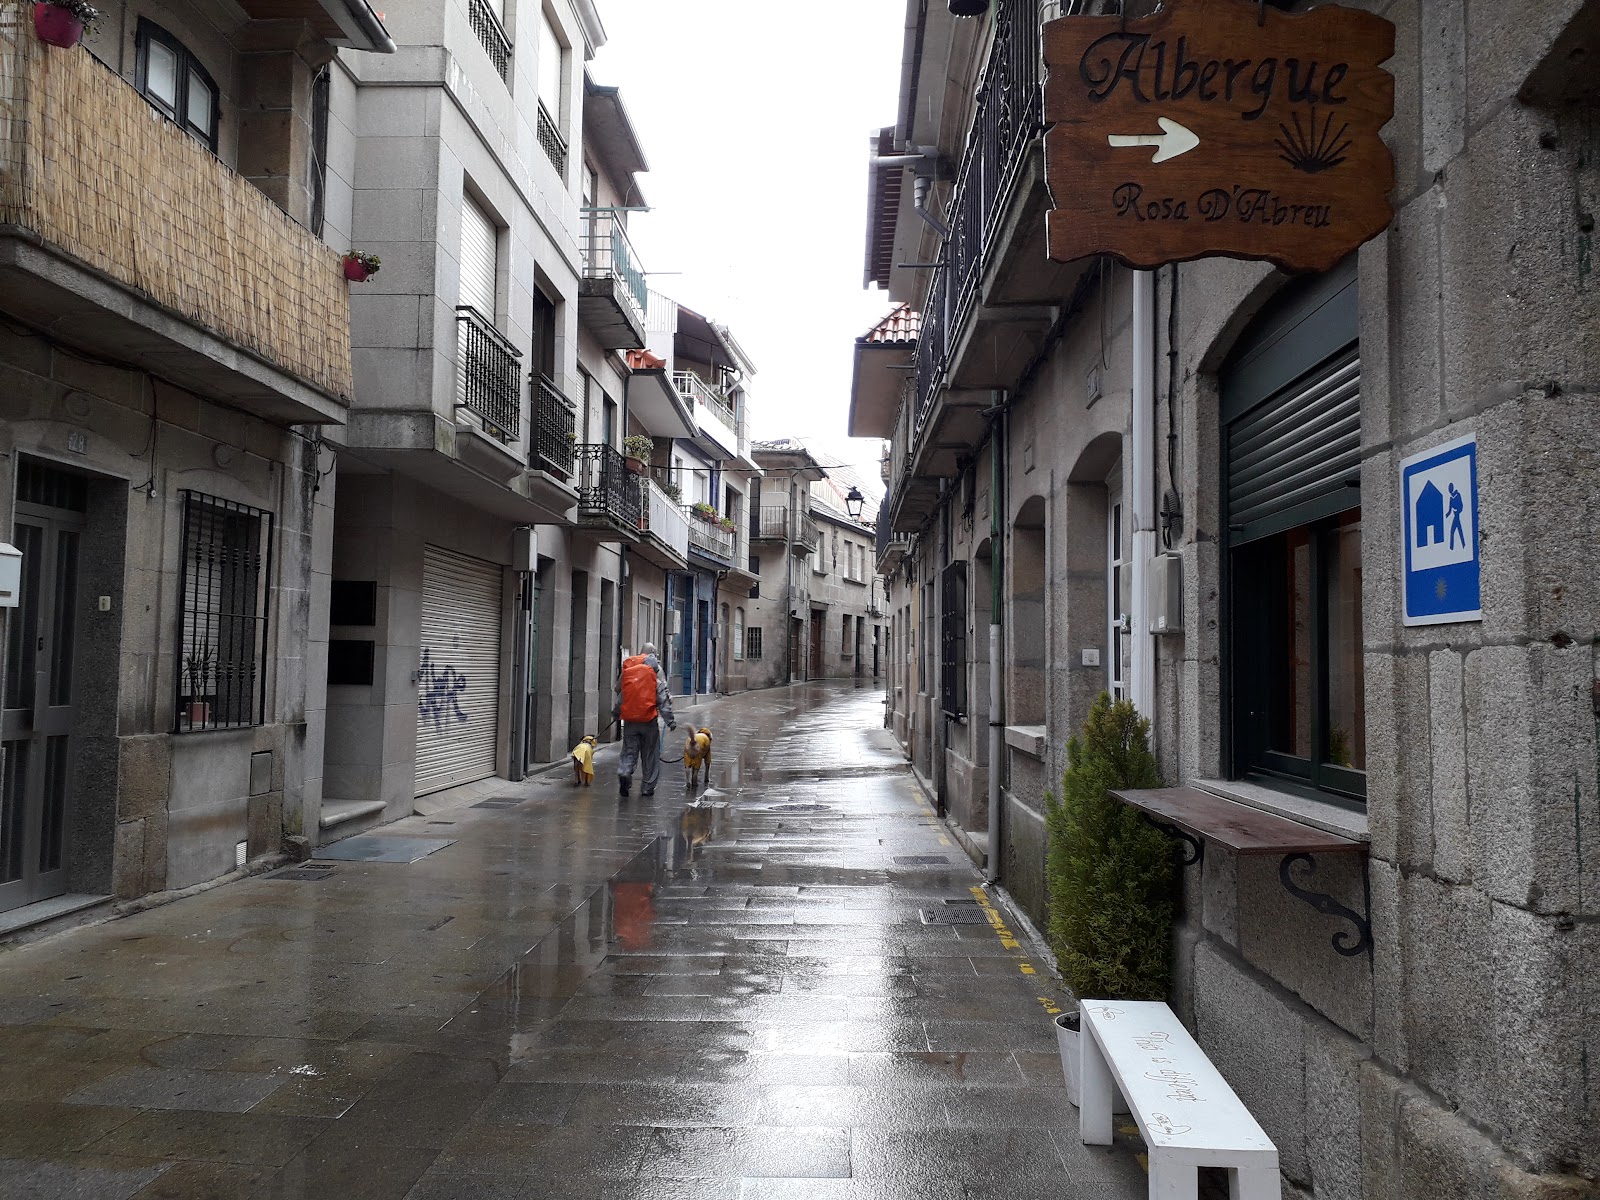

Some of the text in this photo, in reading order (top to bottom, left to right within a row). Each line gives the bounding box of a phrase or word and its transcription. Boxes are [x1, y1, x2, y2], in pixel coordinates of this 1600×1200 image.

[1079, 32, 1349, 120] Albergue
[1112, 183, 1331, 228] Rosa D'Abreu
